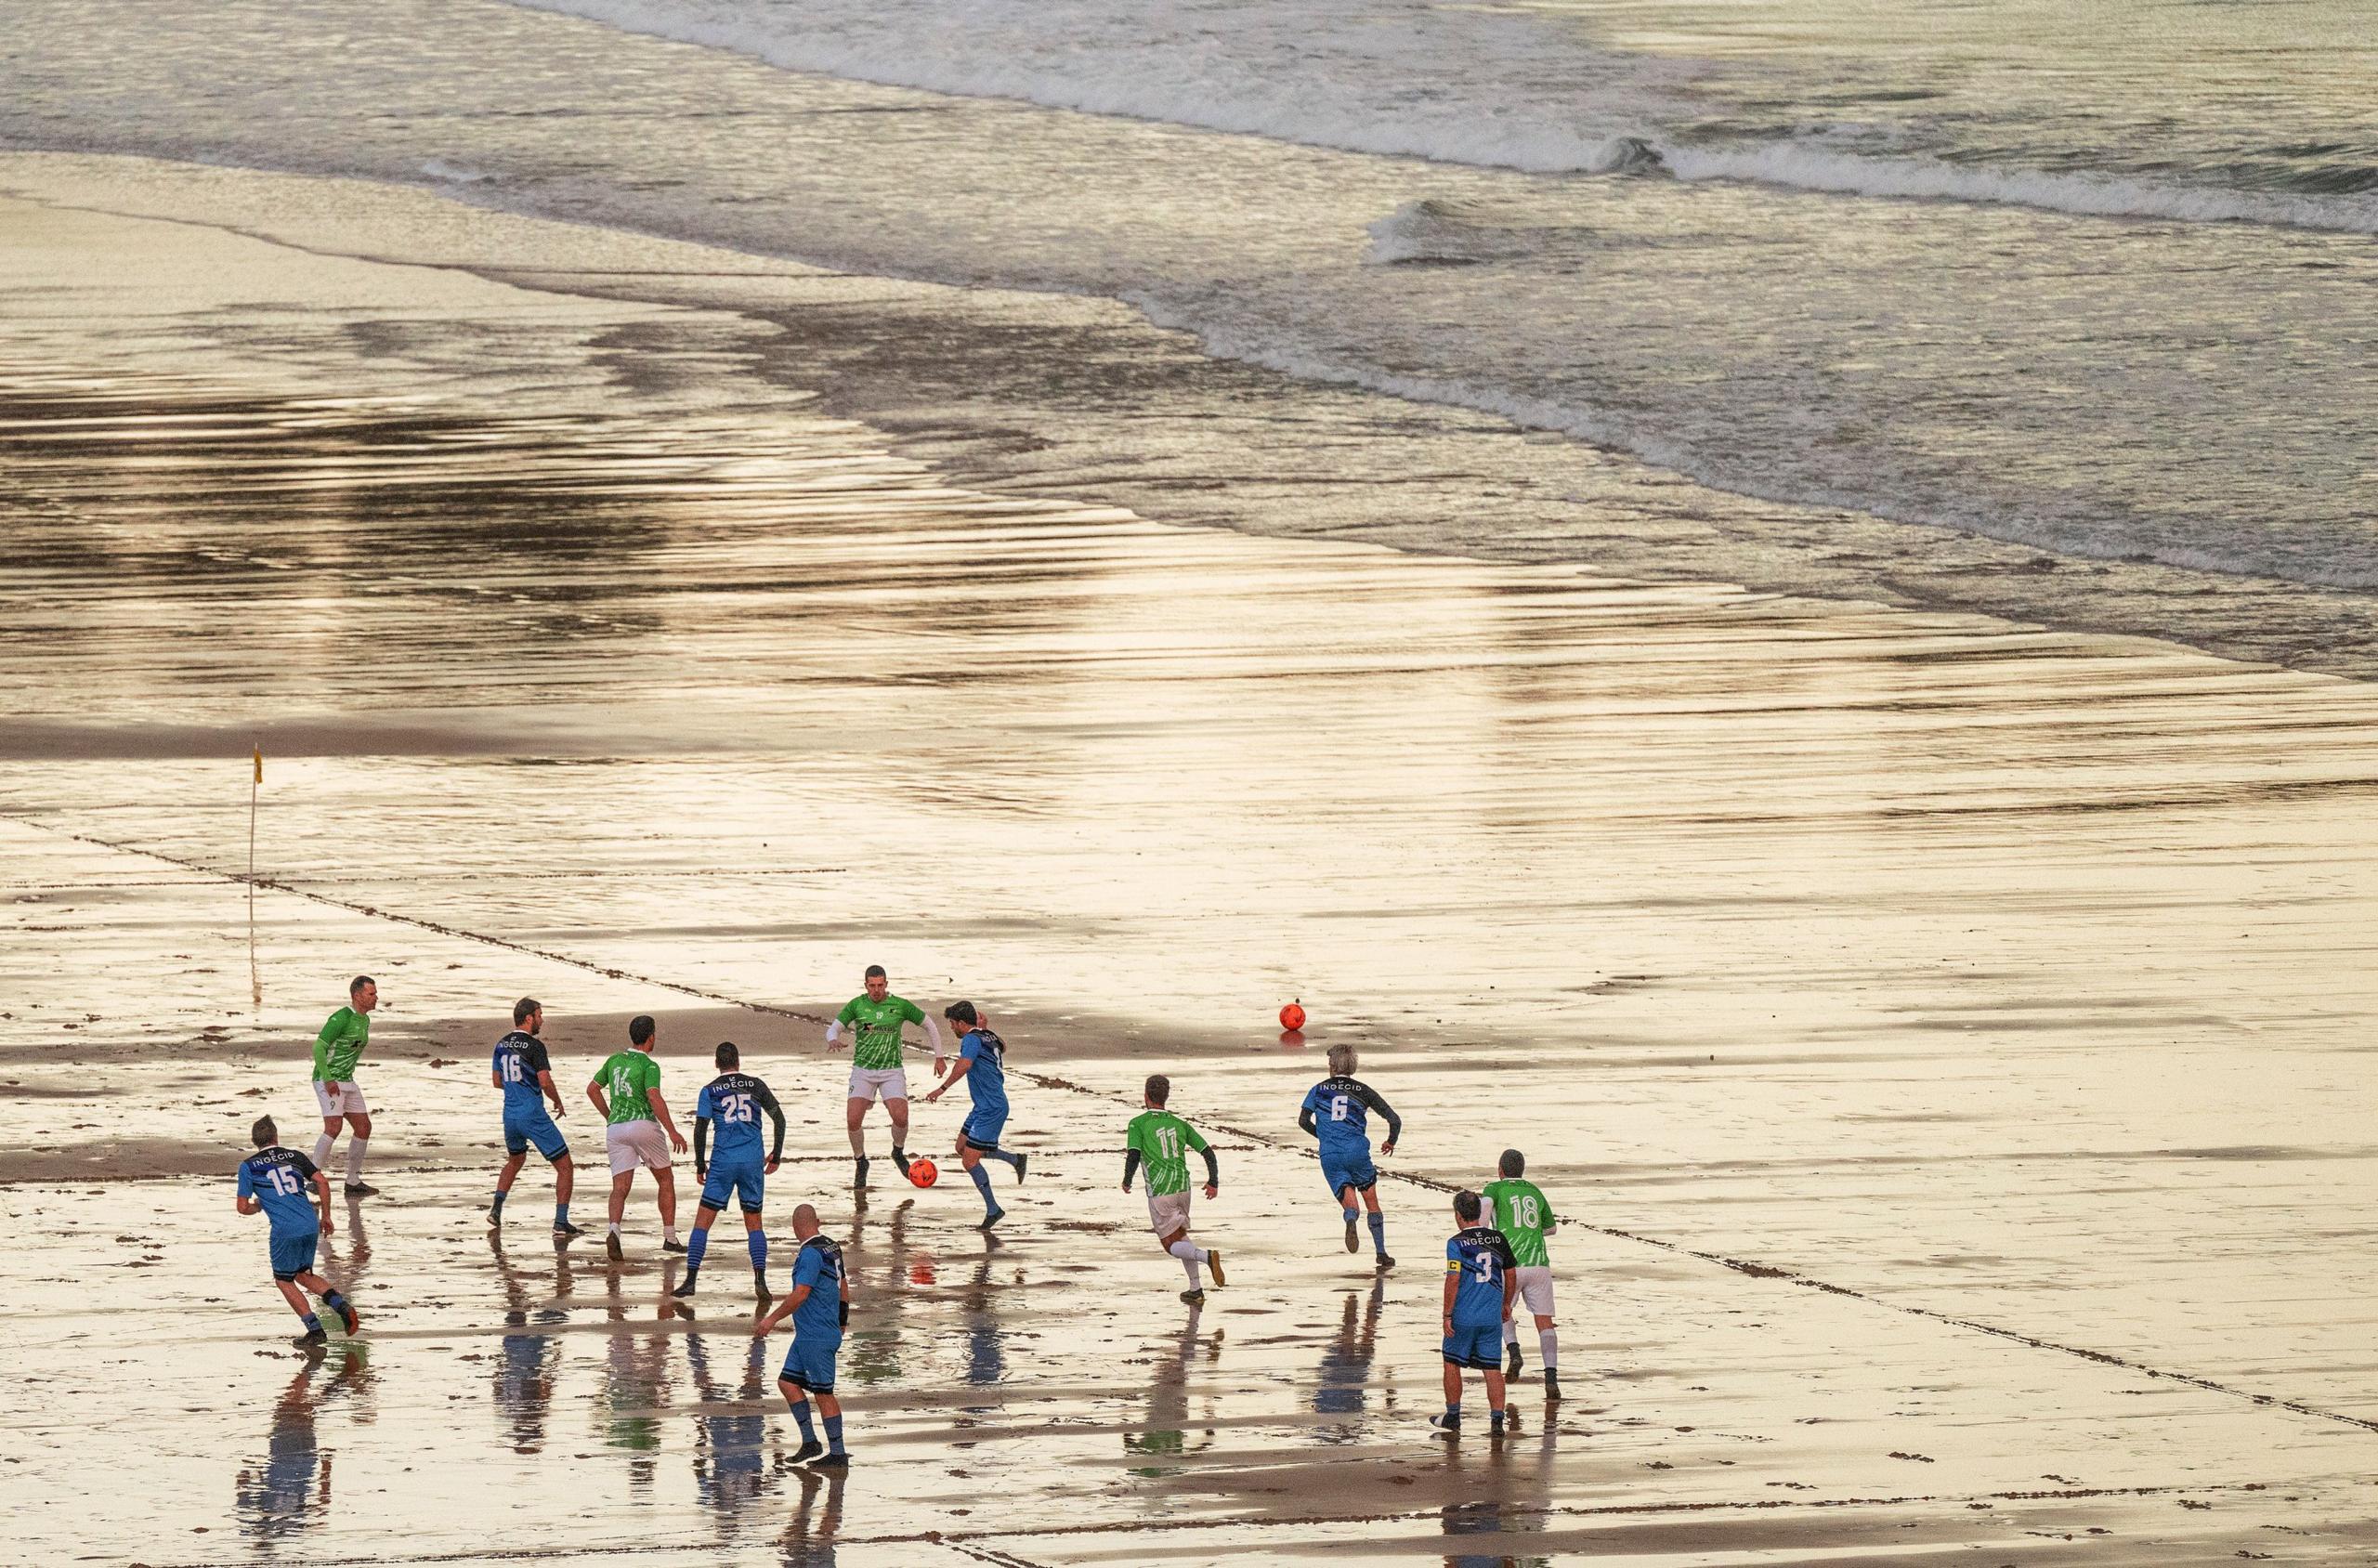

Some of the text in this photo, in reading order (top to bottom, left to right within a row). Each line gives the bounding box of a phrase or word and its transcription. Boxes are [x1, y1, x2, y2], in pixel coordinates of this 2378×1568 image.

[501, 1054, 522, 1081] 16
[613, 1066, 633, 1097] 14
[712, 1080, 754, 1093] INGECID
[721, 1093, 752, 1124] 25
[1331, 1095, 1348, 1121] 6
[1156, 1126, 1179, 1159] 11
[252, 1152, 294, 1168] INGECID
[266, 1165, 298, 1196] 15
[1509, 1195, 1539, 1229] 18
[1459, 1236, 1501, 1248] INGECID
[1475, 1251, 1492, 1283] 3
